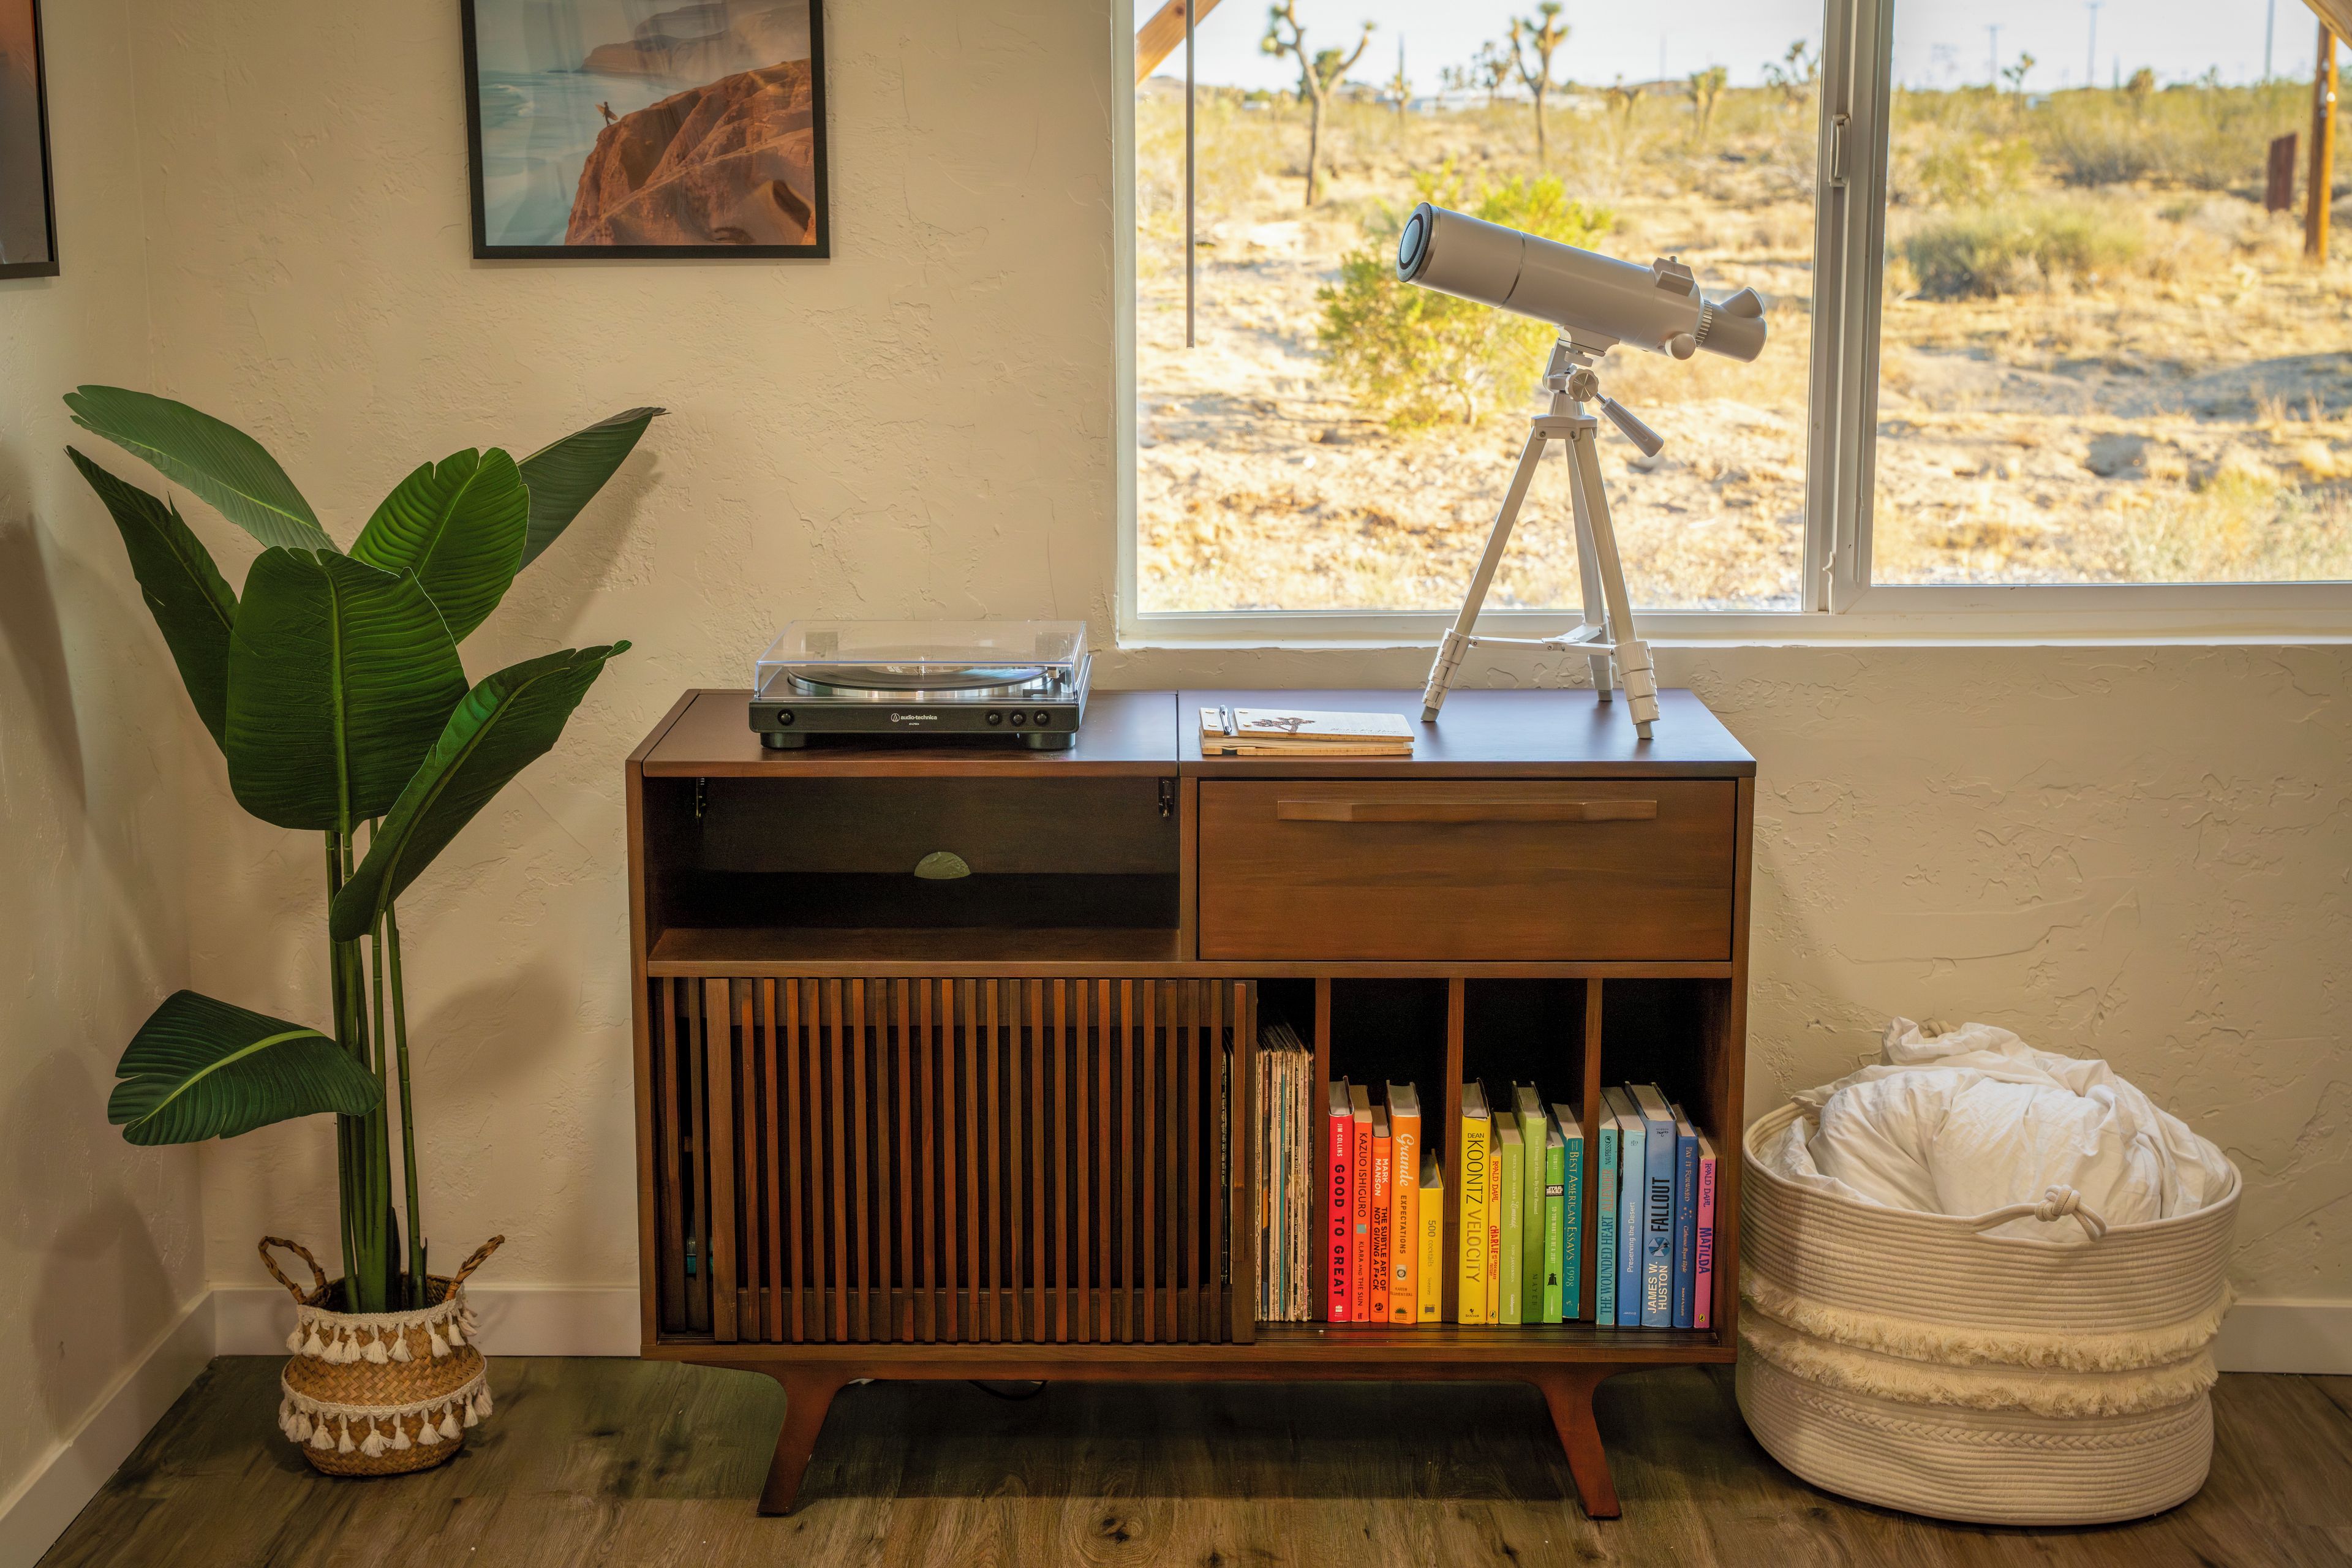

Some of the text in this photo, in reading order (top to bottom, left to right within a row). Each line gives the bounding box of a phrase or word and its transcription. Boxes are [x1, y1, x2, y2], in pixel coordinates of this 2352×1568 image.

[1358, 1133, 1367, 1218] KAZUO ISHIGURO
[1396, 1133, 1414, 1187] Grande
[1466, 1140, 1484, 1204] KOONTZ
[1333, 1164, 1345, 1297] GOOD TO GREAT
[1565, 1152, 1579, 1287] BEST AMERICAN ESSAYS 1998
[1651, 1177, 1670, 1232] FALLOUT
[1466, 1209, 1482, 1283] VELOCITY
[1490, 1225, 1499, 1254] CHARLIE
[1600, 1169, 1613, 1314] THE WOUNDED HEART ALLENDER
[1627, 1237, 1636, 1273] Preserving
[1699, 1227, 1712, 1274] MATILDA
[1380, 1280, 1386, 1291] OF
[1646, 1262, 1658, 1314] JAMES W.
[1658, 1265, 1668, 1310] HUSTON
